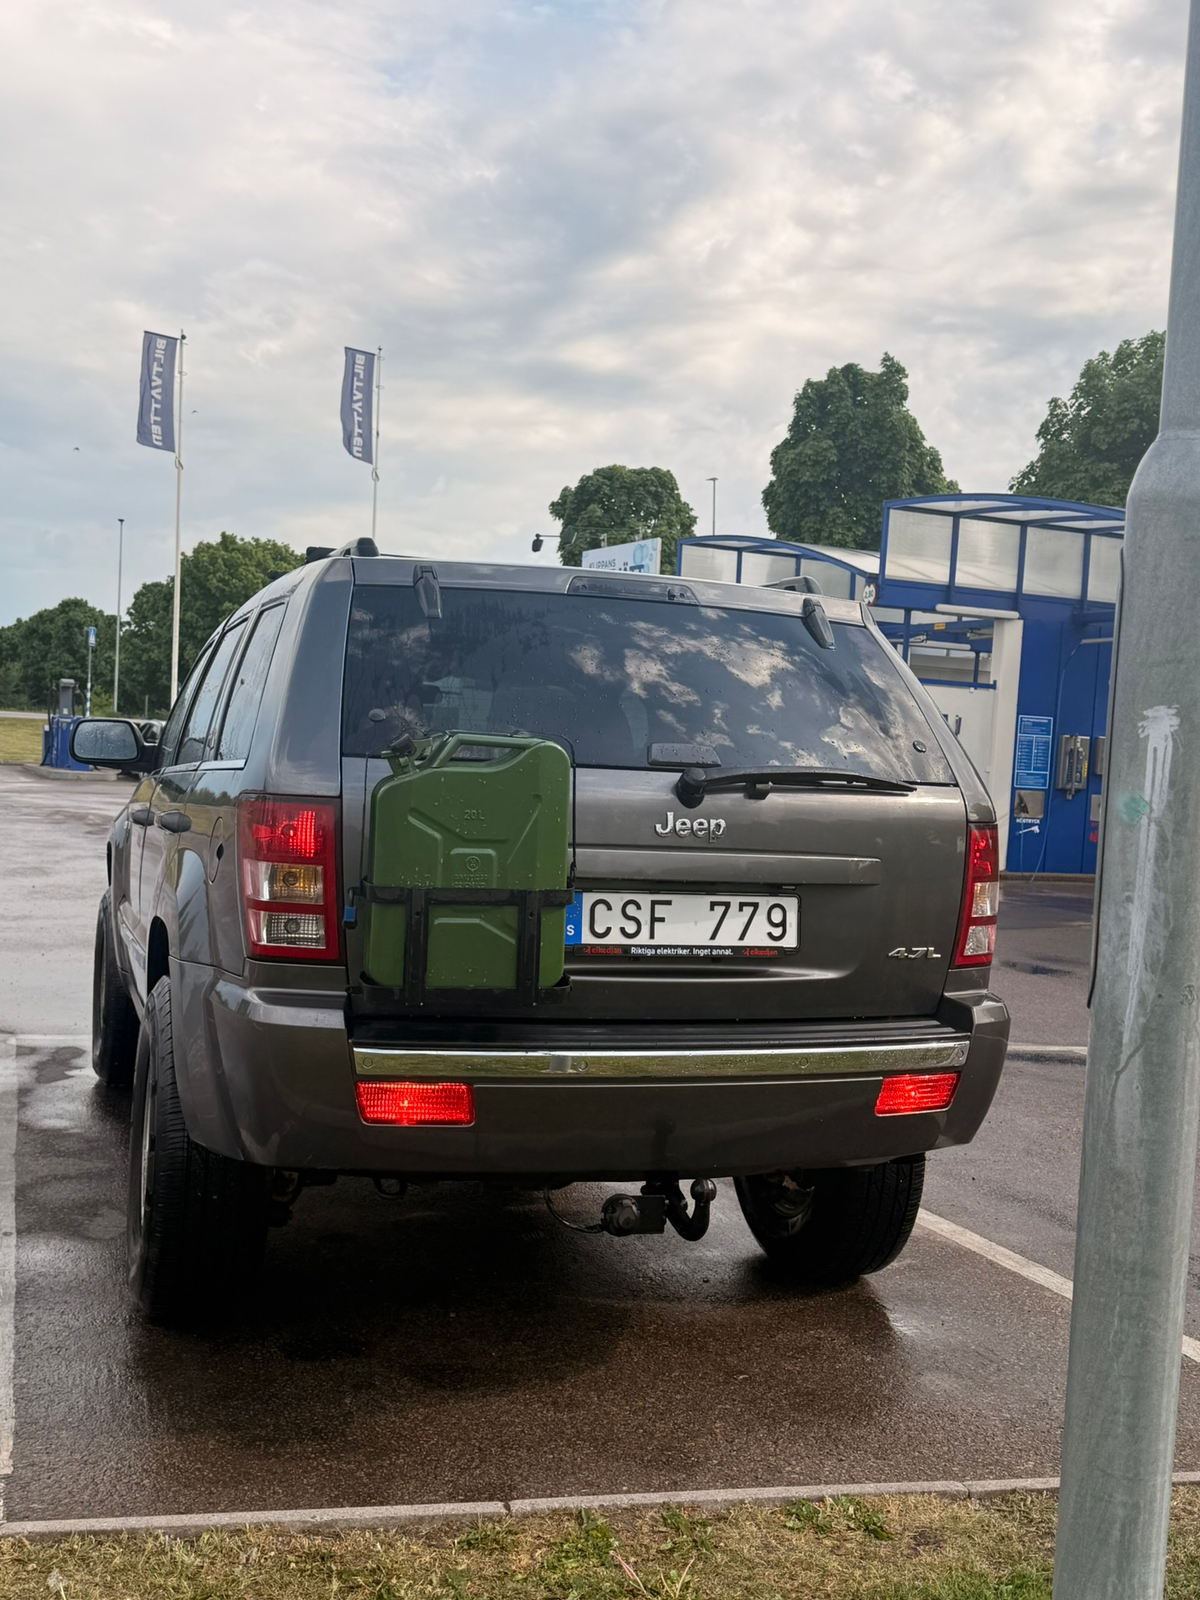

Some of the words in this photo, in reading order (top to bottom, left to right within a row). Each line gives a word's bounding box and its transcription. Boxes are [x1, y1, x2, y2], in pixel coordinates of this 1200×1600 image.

[464, 809, 477, 820] 20
[479, 809, 485, 820] L
[654, 811, 727, 843] Jeep
[589, 898, 672, 940] CSF
[709, 902, 787, 942] 779
[566, 924, 575, 936] S
[630, 946, 656, 956] Riktiga
[657, 948, 692, 956] elektriker.
[693, 948, 710, 956] Inget
[888, 947, 942, 959] 4.7L
